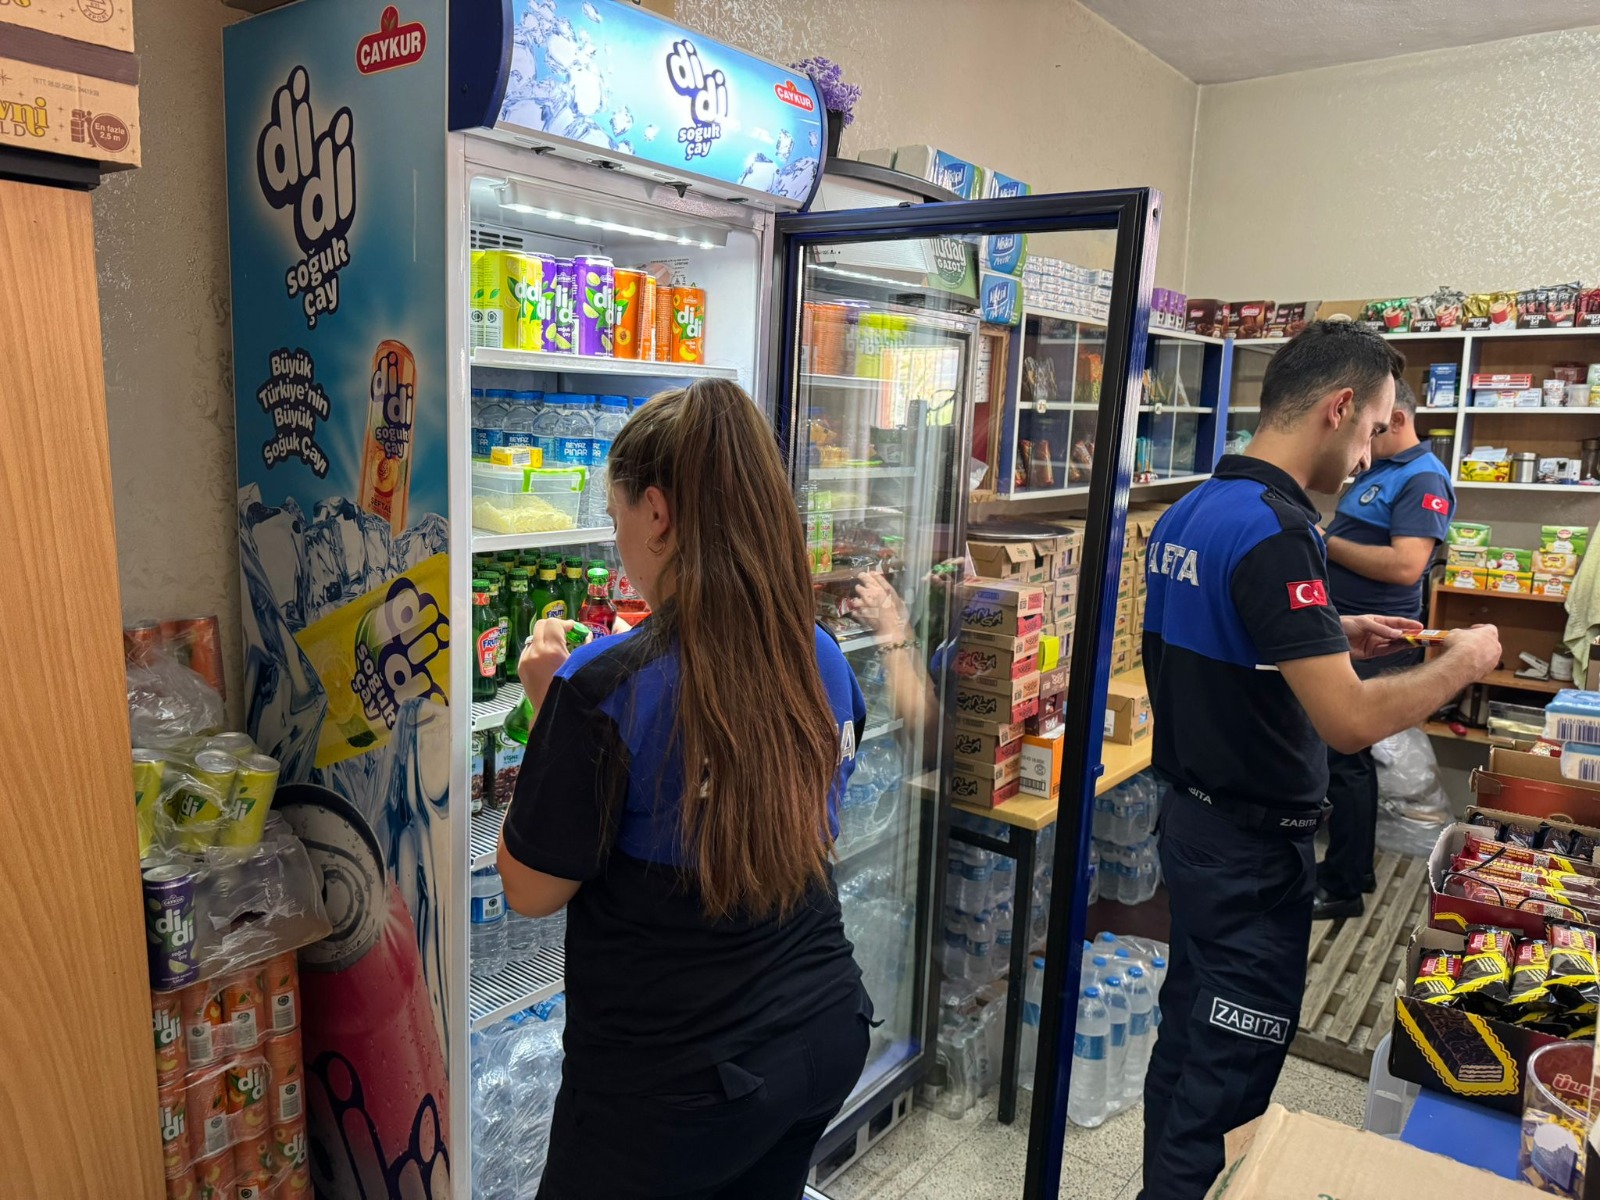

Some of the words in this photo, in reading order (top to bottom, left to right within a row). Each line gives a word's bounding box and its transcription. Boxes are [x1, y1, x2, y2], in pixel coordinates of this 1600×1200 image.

[360, 30, 422, 69] ÇAYKUR
[668, 40, 704, 89] di
[695, 70, 728, 122] di
[777, 85, 812, 109] ÇAYKUR
[94, 122, 106, 131] En
[106, 125, 125, 135] fazla
[262, 68, 313, 192] di
[678, 123, 721, 143] soğuk
[686, 140, 712, 160] çay
[300, 112, 354, 241] di
[286, 237, 348, 296] soğuk
[937, 260, 962, 273] GAZOZ
[304, 278, 338, 326] çay
[271, 353, 312, 379] Büyük
[259, 378, 329, 417] Türkiye'nin
[274, 404, 313, 431] Büyük
[1280, 818, 1317, 828] ZABITA
[155, 908, 181, 934] di
[171, 919, 194, 947] di
[160, 1017, 182, 1044] di
[1215, 1003, 1282, 1039] ZABITA
[238, 1068, 260, 1091] di
[163, 1114, 185, 1142] di
